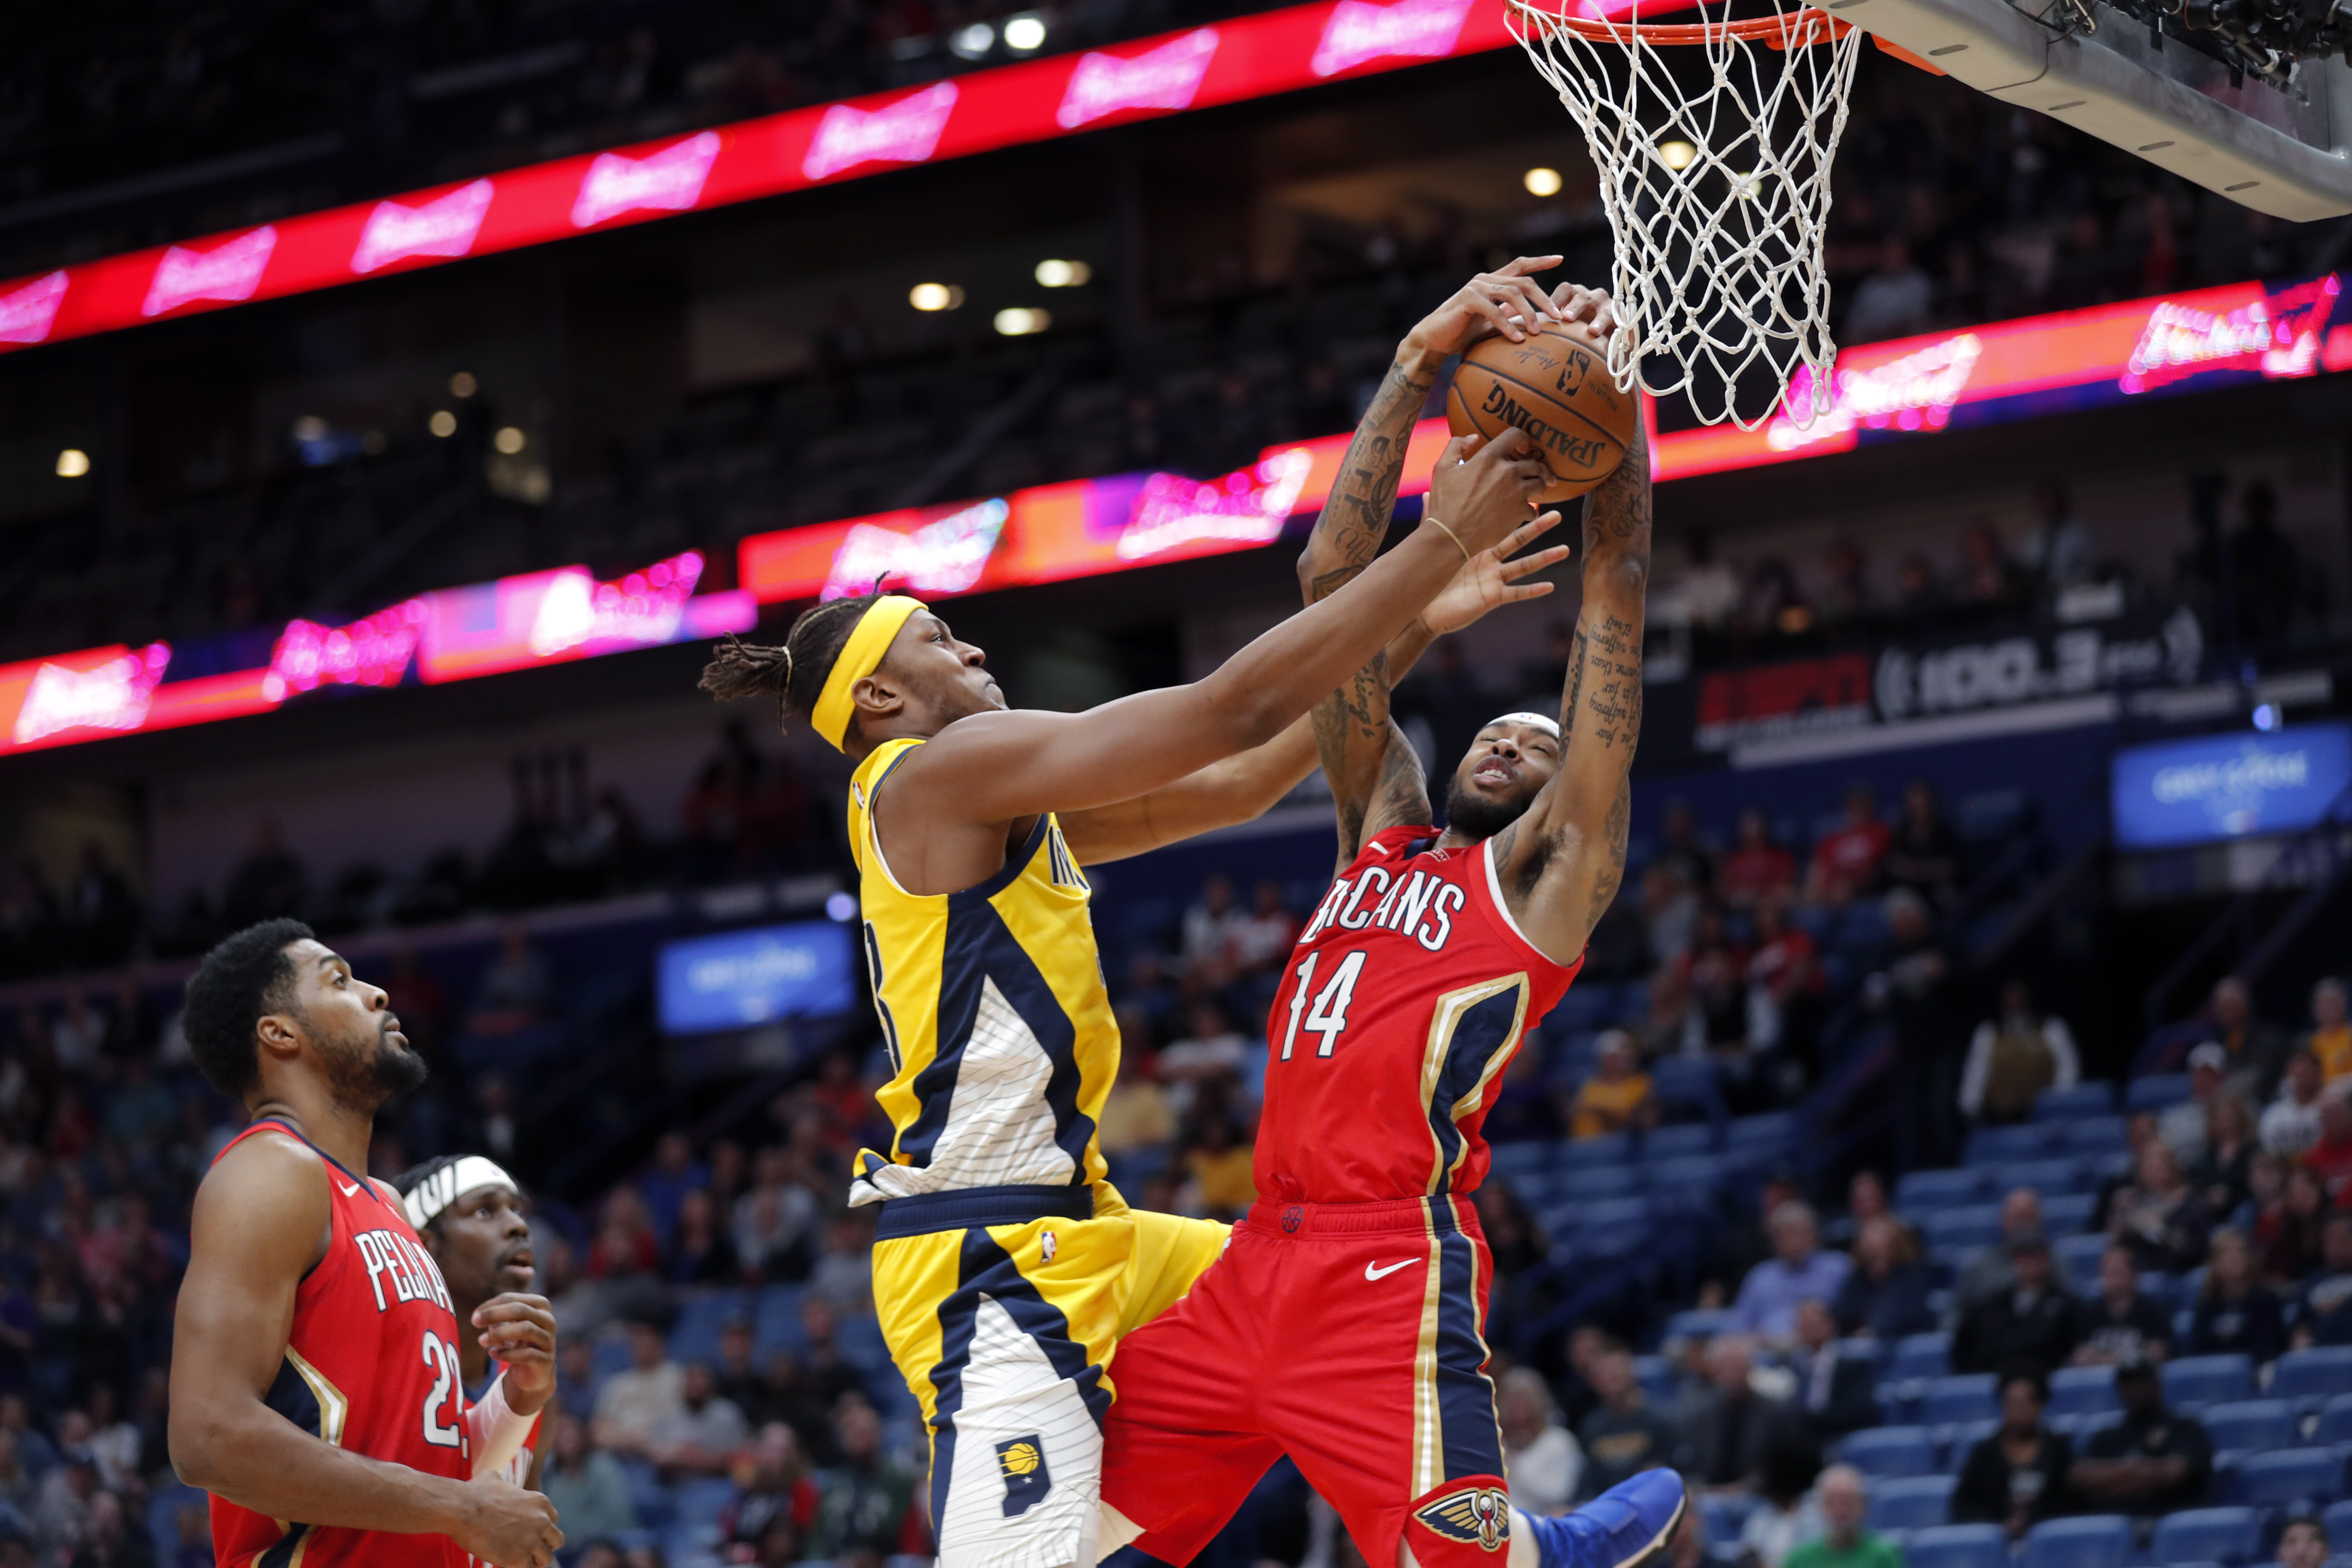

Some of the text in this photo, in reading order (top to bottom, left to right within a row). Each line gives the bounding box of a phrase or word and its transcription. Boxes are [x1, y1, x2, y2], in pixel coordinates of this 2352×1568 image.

[1481, 383, 1607, 469] SPALDING
[1591, 655, 1612, 677] than
[1602, 680, 1621, 701] far
[1047, 823, 1092, 893] IN
[1280, 949, 1368, 1062] 14
